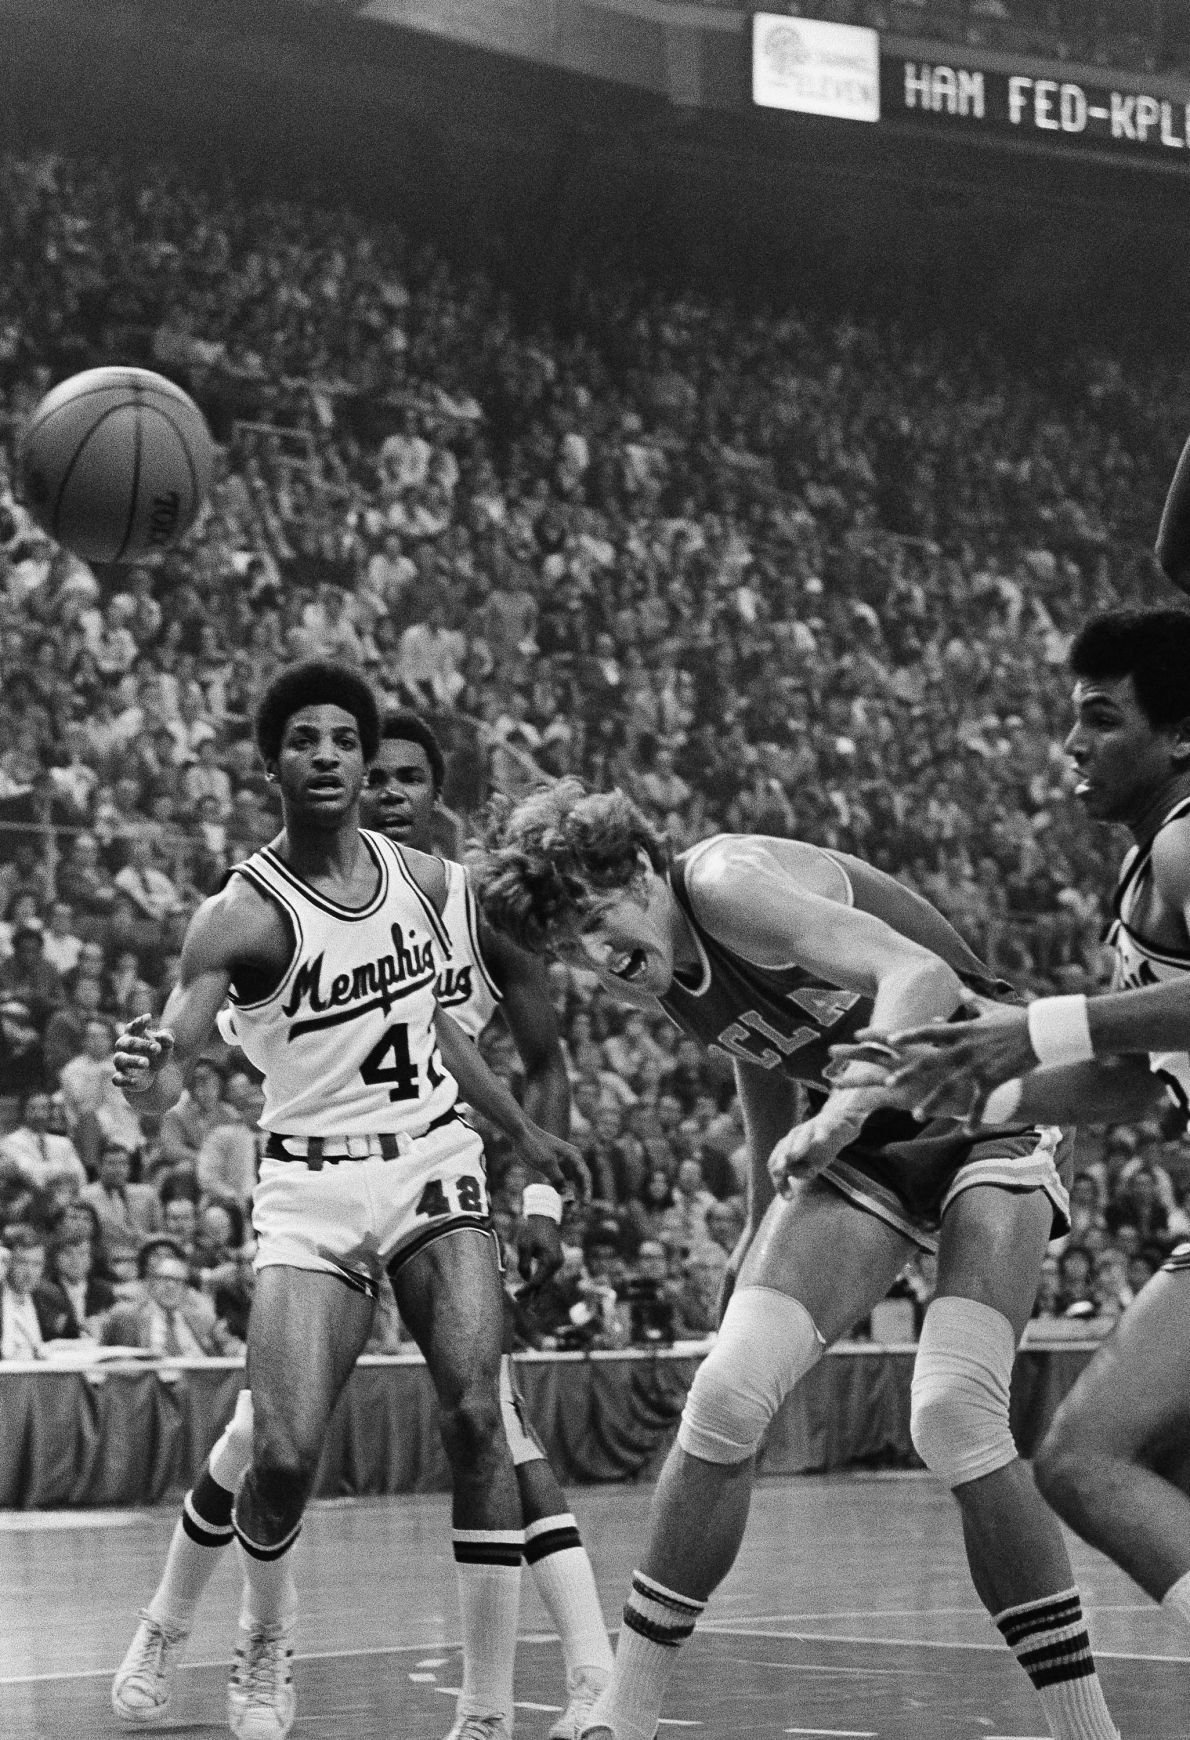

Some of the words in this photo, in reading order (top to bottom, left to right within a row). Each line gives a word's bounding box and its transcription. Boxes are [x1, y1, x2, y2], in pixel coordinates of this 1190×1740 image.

[905, 61, 985, 119] HAM
[1009, 75, 1190, 150] FED-KPL
[282, 922, 437, 1020] Memphis
[707, 987, 862, 1070] CLA
[415, 1175, 482, 1218] 42
